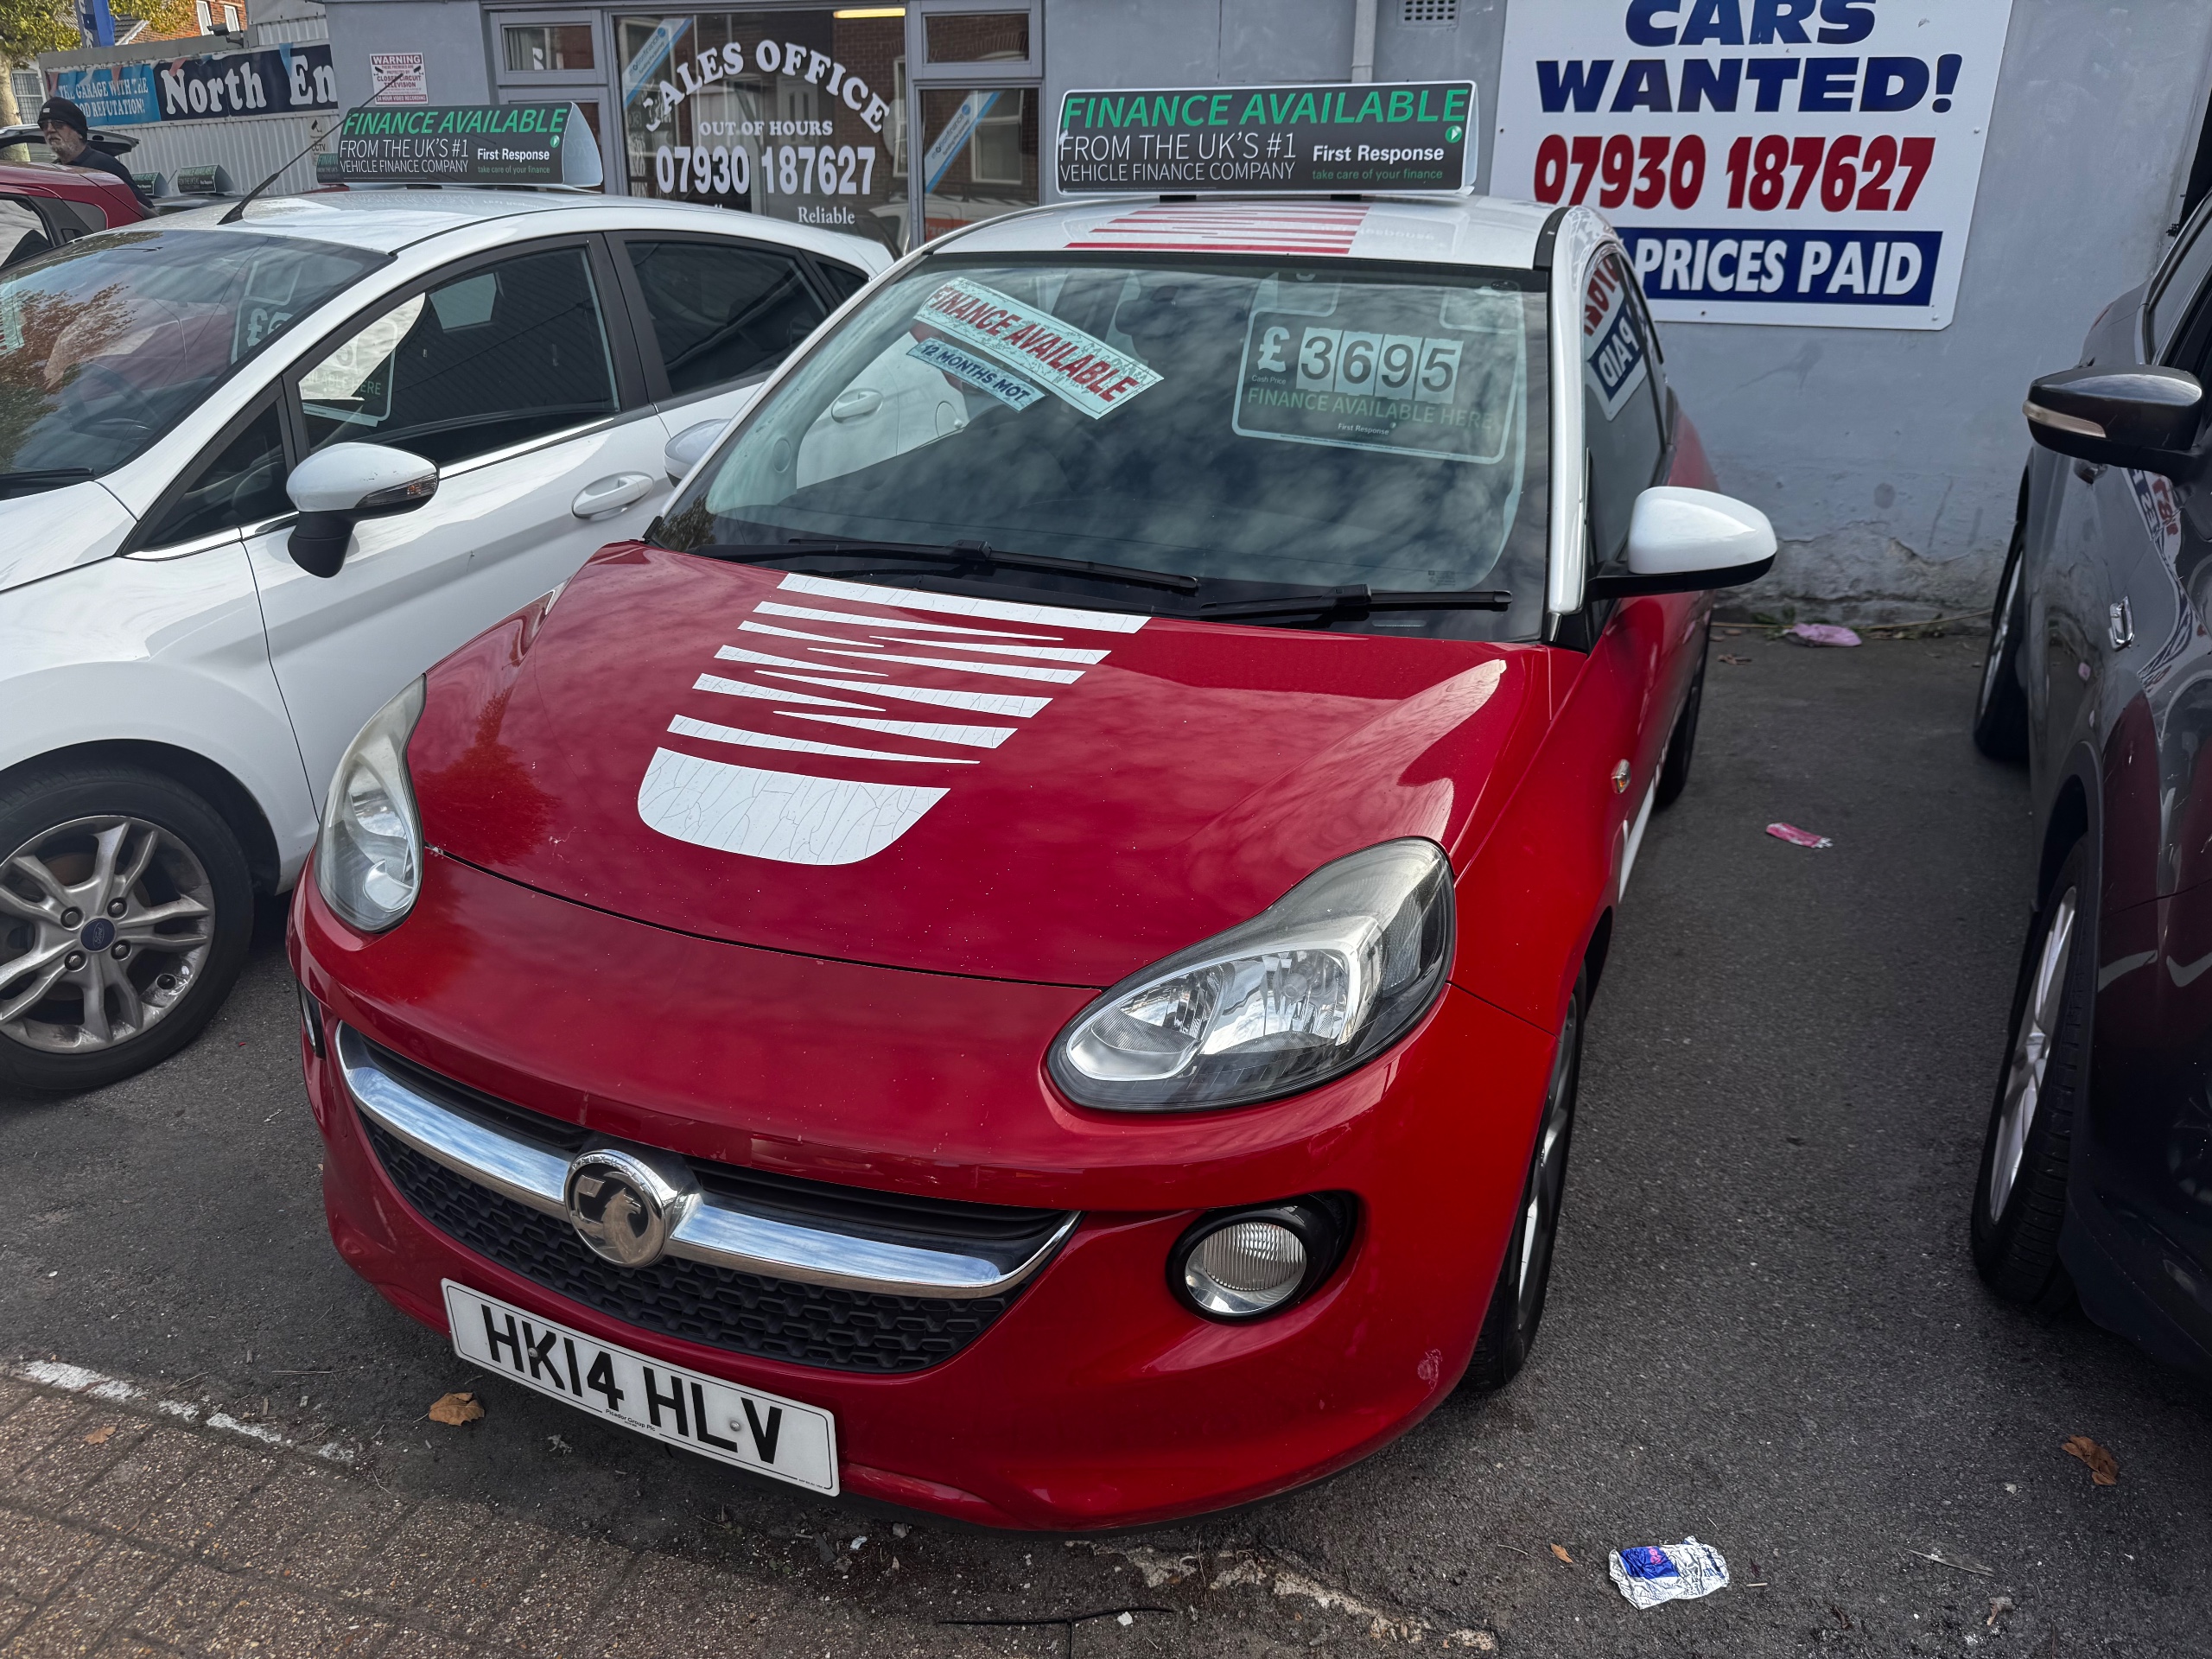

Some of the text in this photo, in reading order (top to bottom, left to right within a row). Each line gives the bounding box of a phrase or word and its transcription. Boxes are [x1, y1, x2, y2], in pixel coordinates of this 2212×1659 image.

[1625, 0, 1877, 47] CARS
[373, 56, 421, 65] WARNING
[77, 79, 109, 99] GARAGE
[161, 62, 267, 114] North
[756, 40, 889, 133] OFFICE
[1536, 54, 1962, 113] WANTED!
[1062, 89, 1469, 130] FINANCE AVAILABLE
[342, 108, 568, 136] FINANCE AVAILABLE
[699, 120, 833, 137] OUT OF HOURS
[340, 138, 469, 158] FROM THE UK'S #1
[477, 148, 550, 162] First Response
[1059, 132, 1296, 162] FROM THE UK'S #1
[1313, 145, 1444, 165] First Response
[340, 161, 378, 173] VEHICLE
[379, 160, 419, 173] FINANCE
[420, 159, 468, 173] COMPANY
[513, 167, 526, 175] your
[528, 165, 550, 174] finance
[656, 145, 875, 195] 07930 187627
[1059, 162, 1295, 182] VEHICLE FINANCE COMPANY
[1312, 168, 1442, 182] take care of your finance
[1534, 134, 1936, 213] 07930 187627
[798, 207, 855, 225] Reliable
[1636, 238, 1923, 296] PRICES PAID
[929, 287, 1022, 337] FINANCE
[1006, 325, 1141, 403] AVAILABLE
[921, 345, 934, 357] 12
[937, 350, 994, 385] MONTHS
[994, 378, 1031, 404] MOT
[1251, 374, 1287, 385] Cash Price
[1248, 388, 1495, 430] FINANCE AVAILABLE HERE
[1338, 423, 1389, 435] First Response
[481, 1304, 783, 1465] HK14 HLV
[606, 1408, 626, 1421] Picador
[627, 1417, 645, 1427] Group
